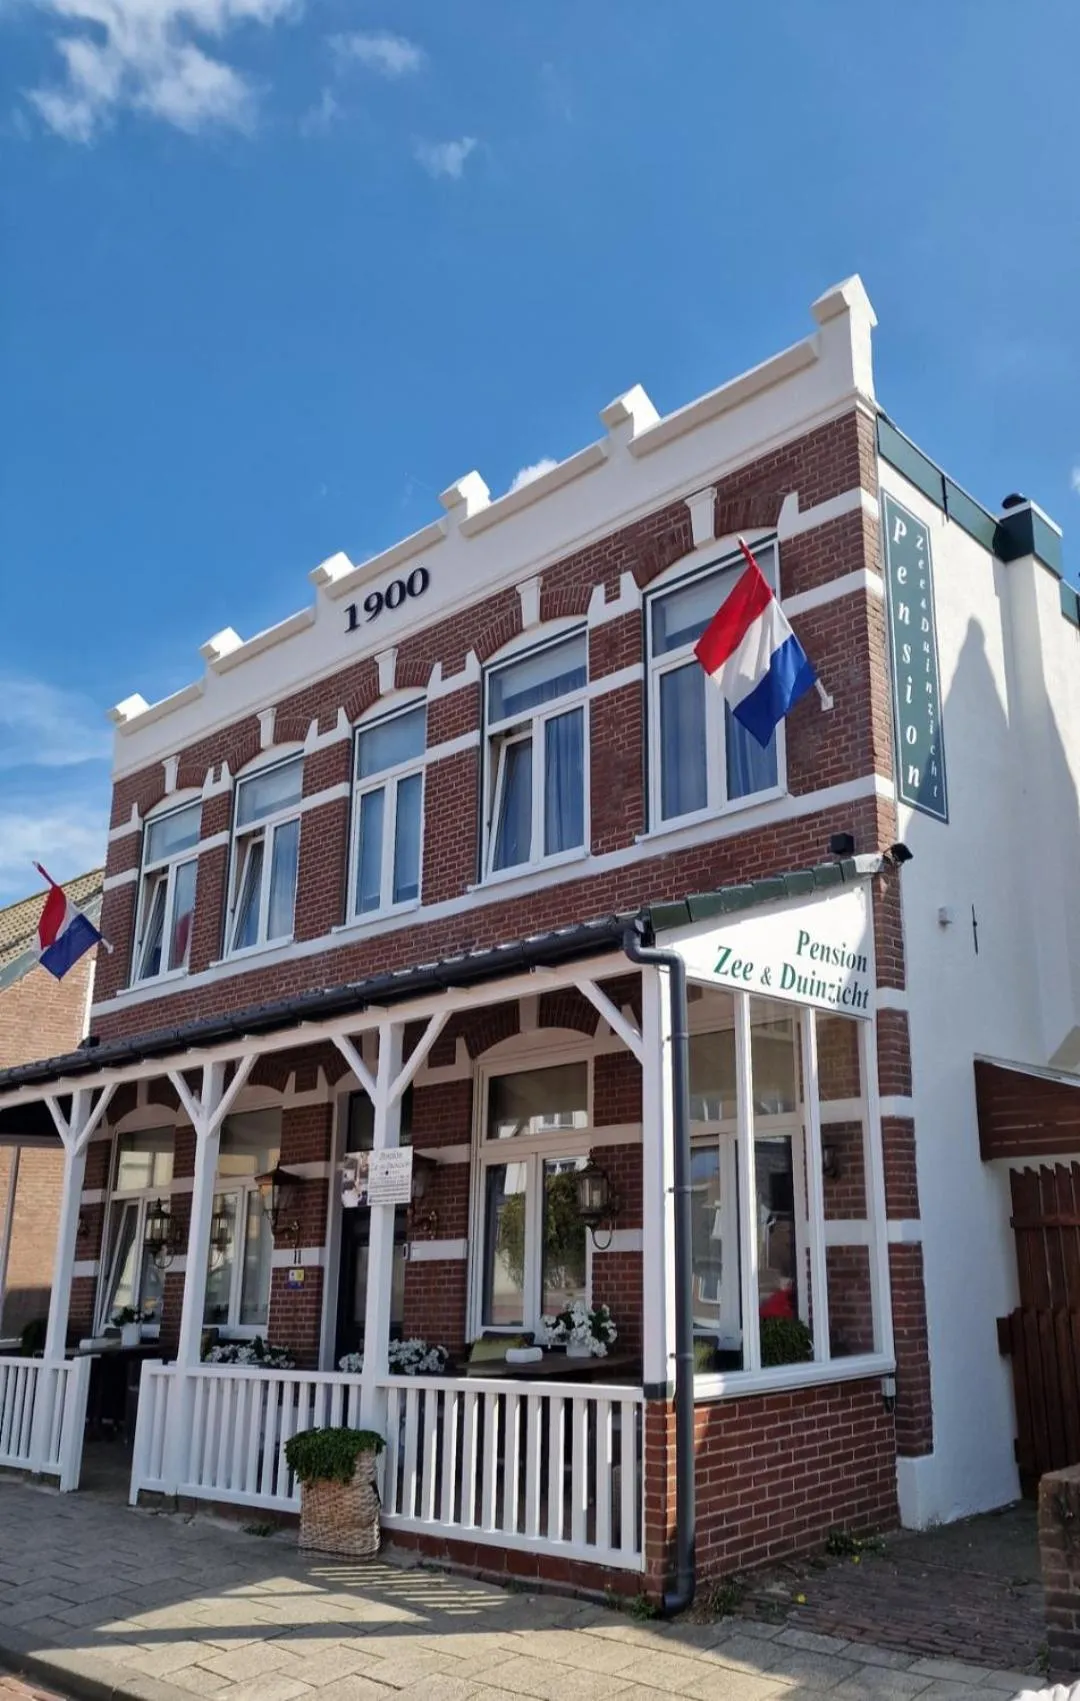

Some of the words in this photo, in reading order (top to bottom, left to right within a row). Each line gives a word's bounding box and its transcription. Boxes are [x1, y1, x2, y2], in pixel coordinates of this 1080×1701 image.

[343, 566, 430, 634] 1900
[893, 515, 920, 788] Pension
[713, 945, 753, 981] Zee
[760, 967, 772, 986] &
[780, 962, 869, 1009] Duinzicht
[796, 930, 867, 973] Pension
